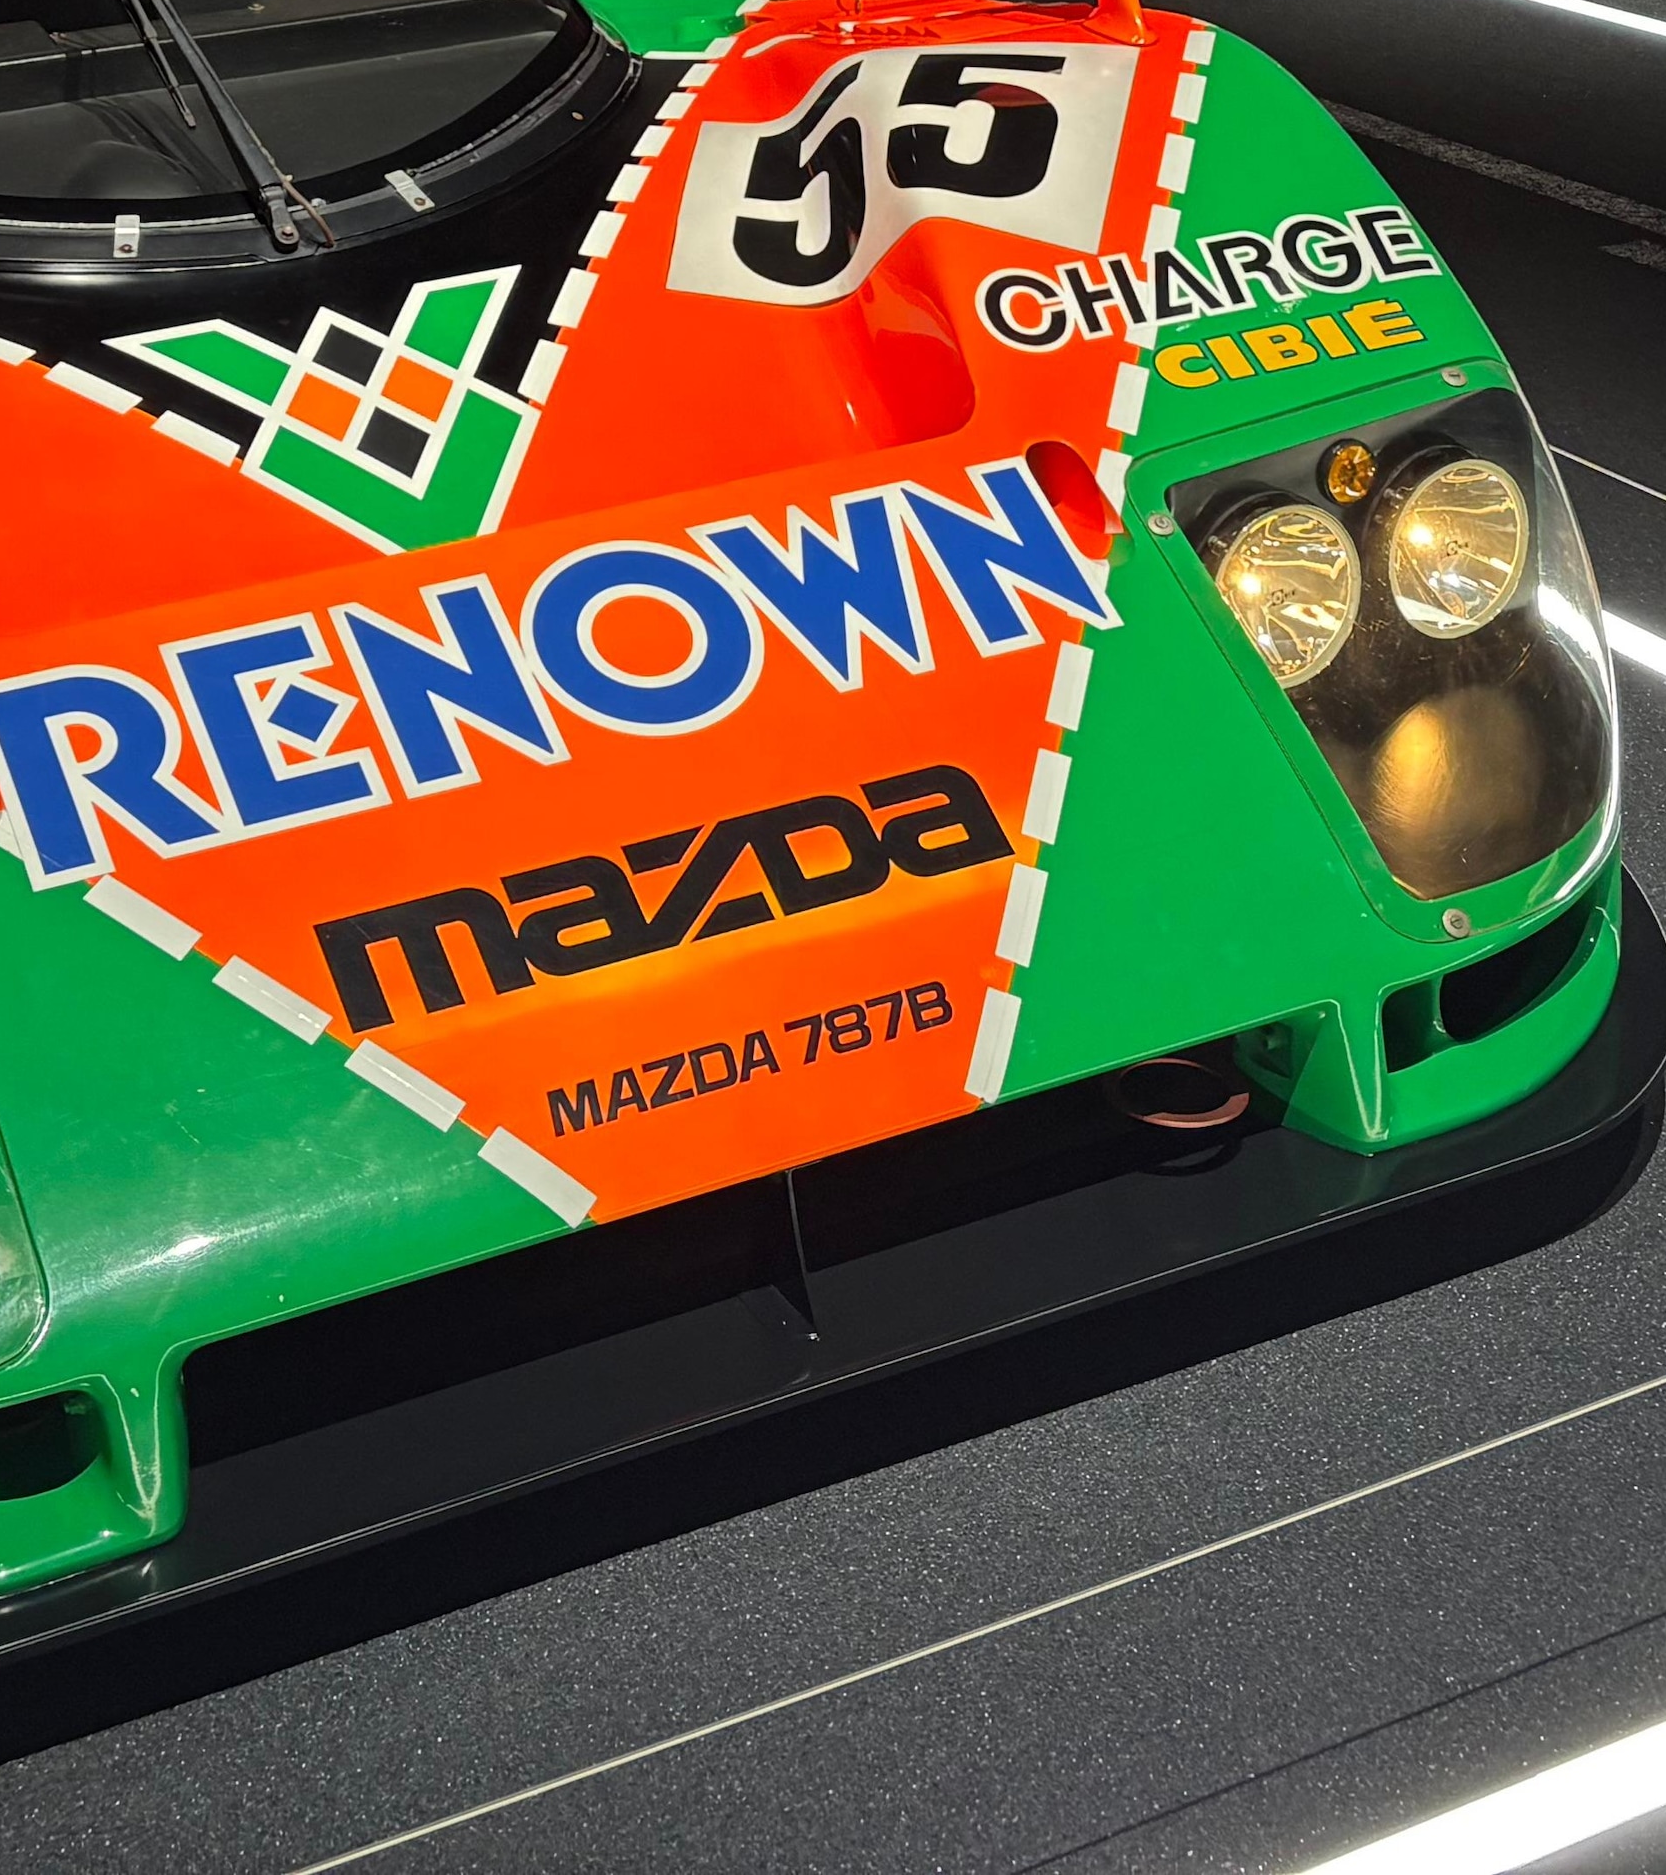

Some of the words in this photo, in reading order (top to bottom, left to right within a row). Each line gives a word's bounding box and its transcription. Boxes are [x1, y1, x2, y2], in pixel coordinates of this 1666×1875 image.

[732, 53, 1066, 287] 55
[974, 204, 1443, 354] CHARGE
[548, 1029, 779, 1138] MAZDA
[783, 980, 954, 1068] 787B
